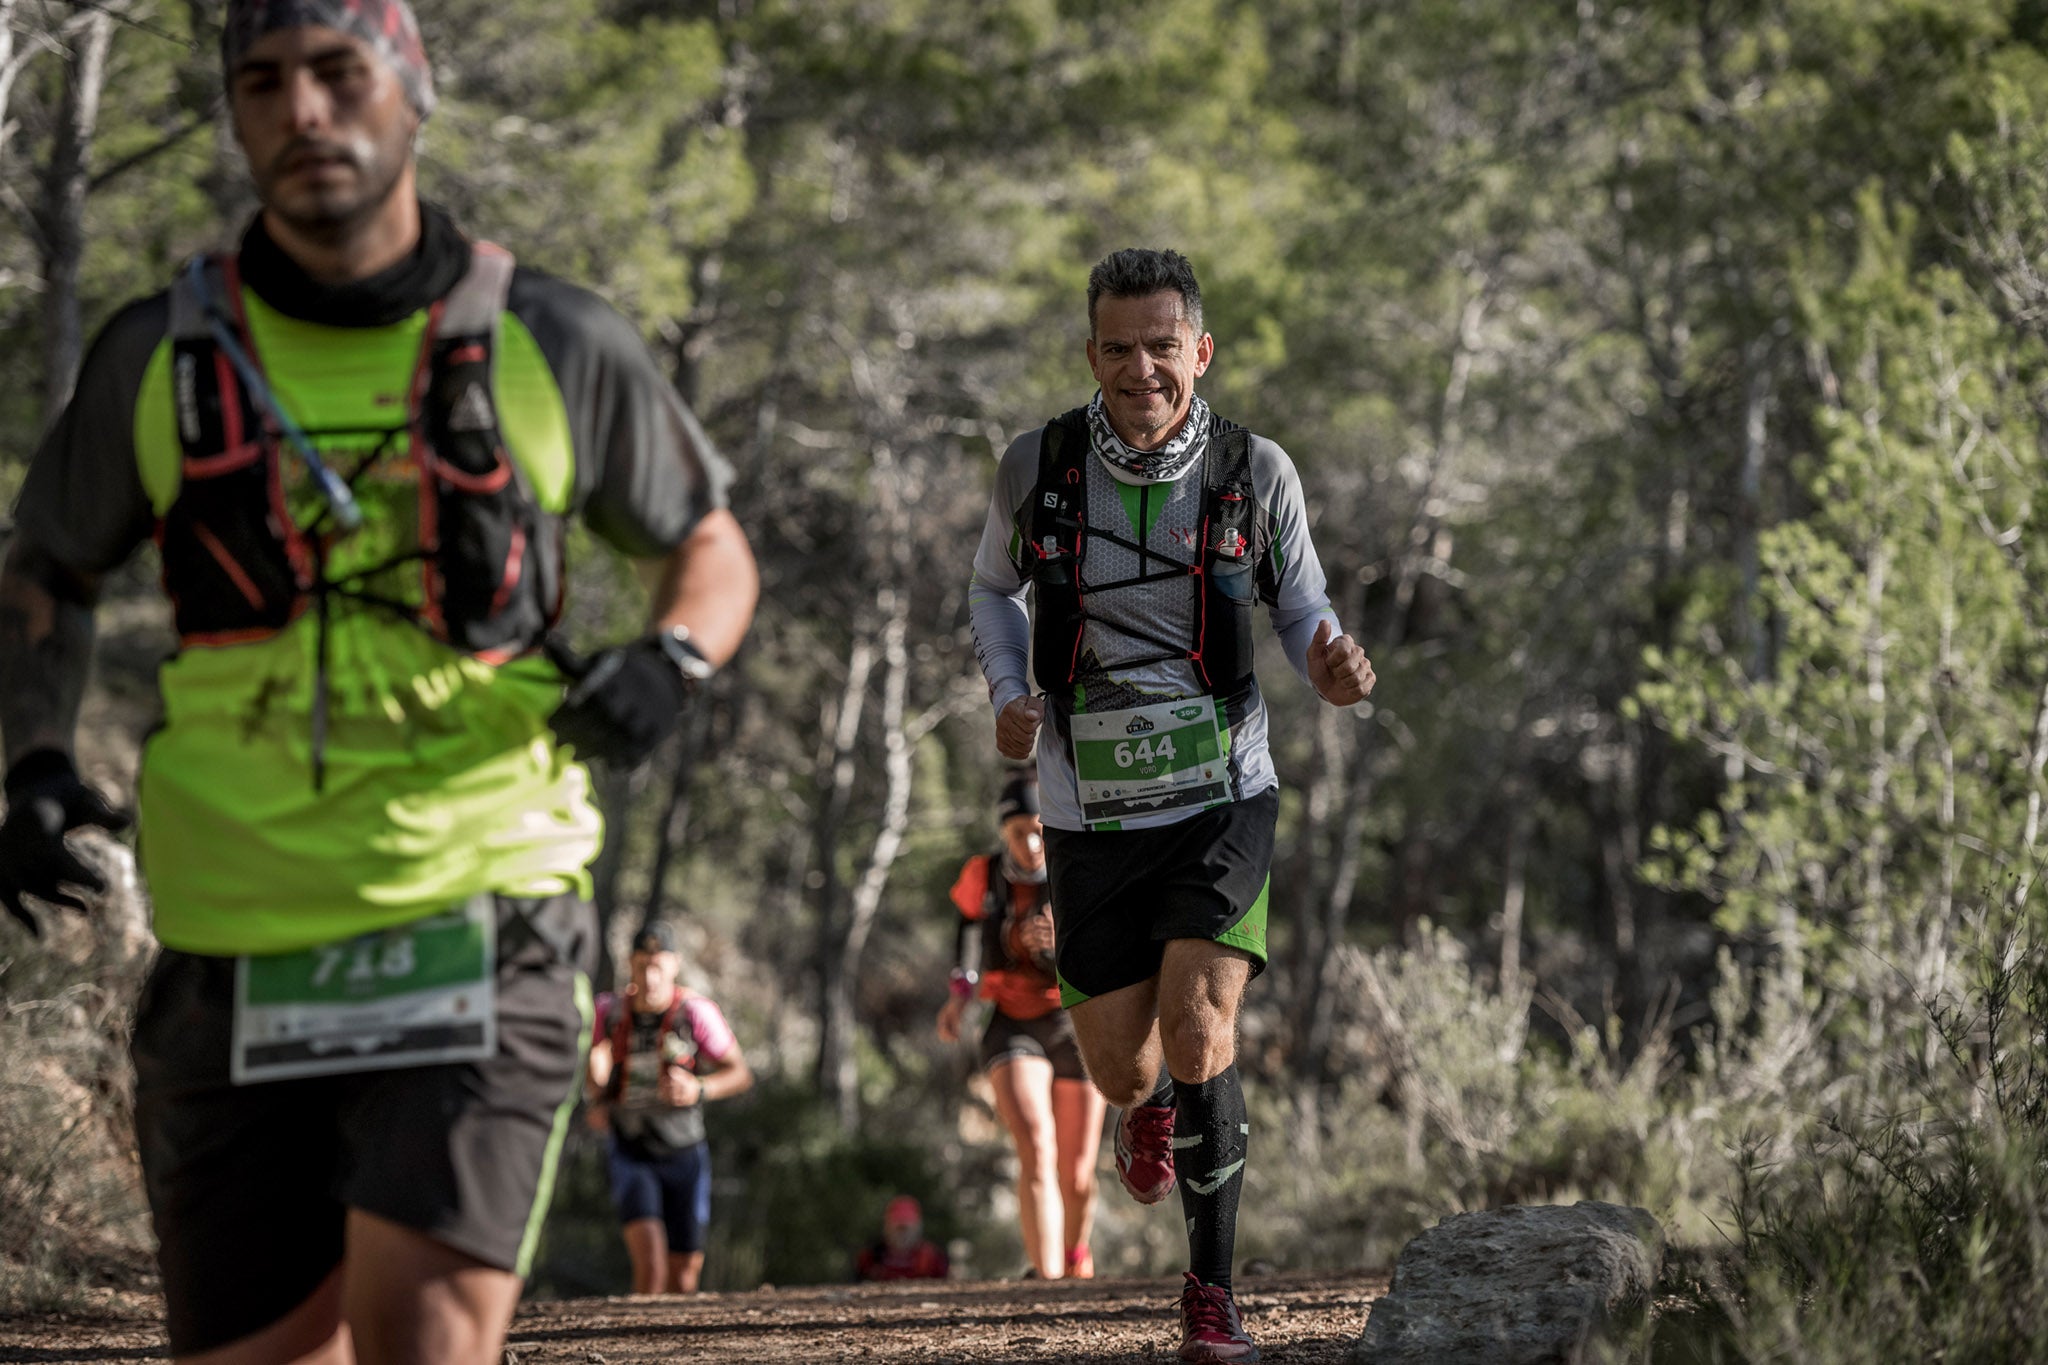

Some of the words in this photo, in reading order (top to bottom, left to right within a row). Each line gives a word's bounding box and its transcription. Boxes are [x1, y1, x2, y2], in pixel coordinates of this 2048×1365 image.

[1180, 709, 1197, 717] 30K
[1127, 722, 1153, 733] TRAIL
[1114, 735, 1177, 768] 644
[1139, 765, 1157, 776] VORO
